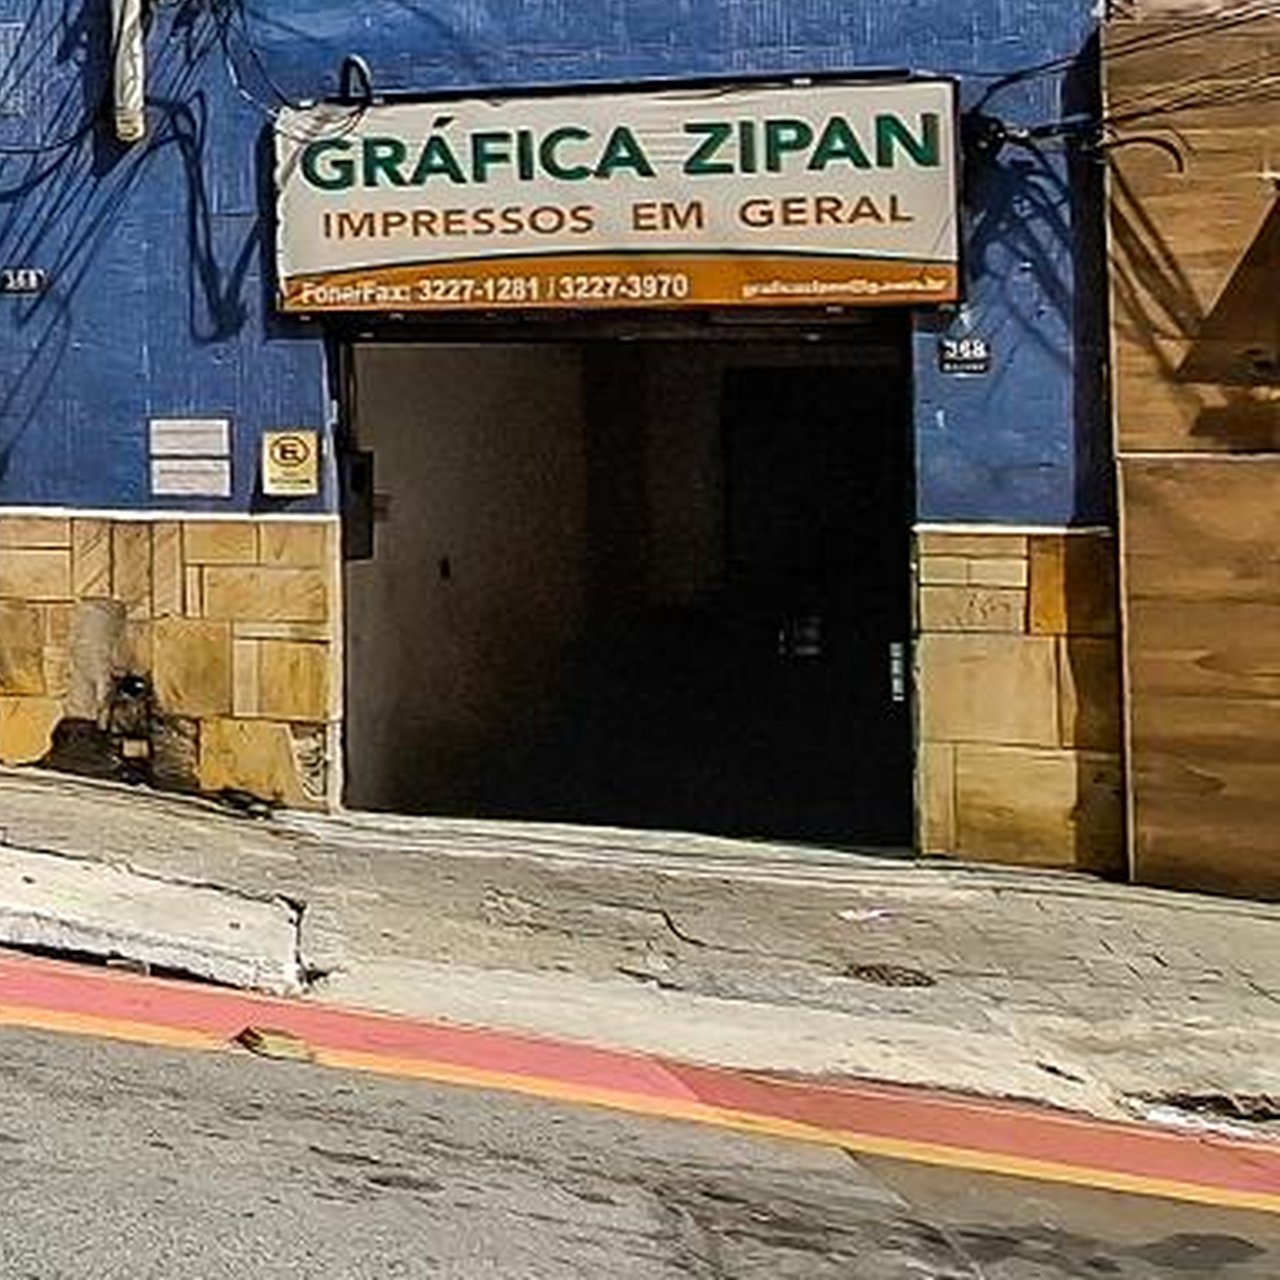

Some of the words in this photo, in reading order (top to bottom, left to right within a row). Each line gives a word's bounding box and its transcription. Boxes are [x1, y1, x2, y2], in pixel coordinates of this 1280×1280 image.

[299, 117, 656, 190] GRÁFICA
[681, 113, 942, 175] ZIPAN
[323, 205, 597, 240] IMPRESSOS
[631, 201, 705, 233] EM
[740, 194, 914, 228] GERAL
[419, 278, 539, 302] 3227-1281
[560, 273, 689, 300] 3227-3970
